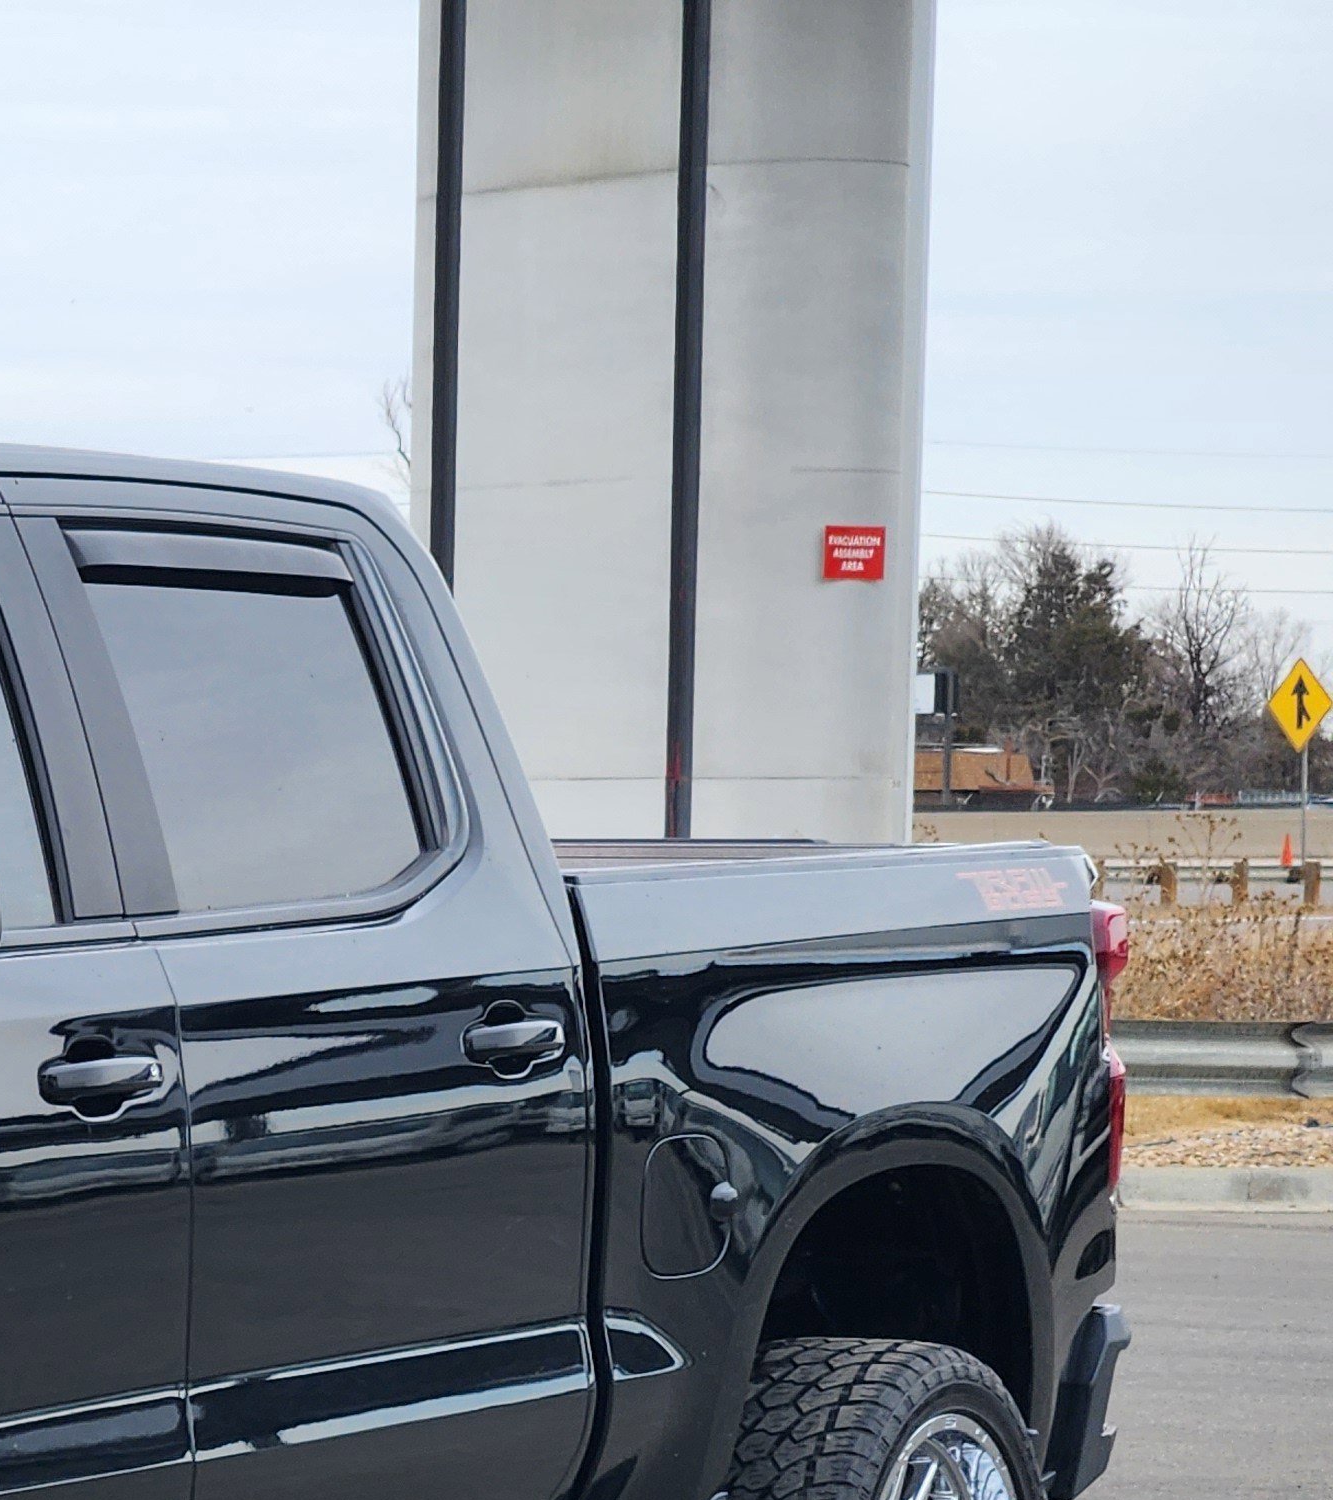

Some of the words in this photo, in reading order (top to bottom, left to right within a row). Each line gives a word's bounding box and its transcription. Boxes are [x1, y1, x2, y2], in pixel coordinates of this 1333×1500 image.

[828, 535, 881, 546] EVACUATION
[832, 547, 874, 559] ASSEMBLY
[840, 560, 865, 571] AREA
